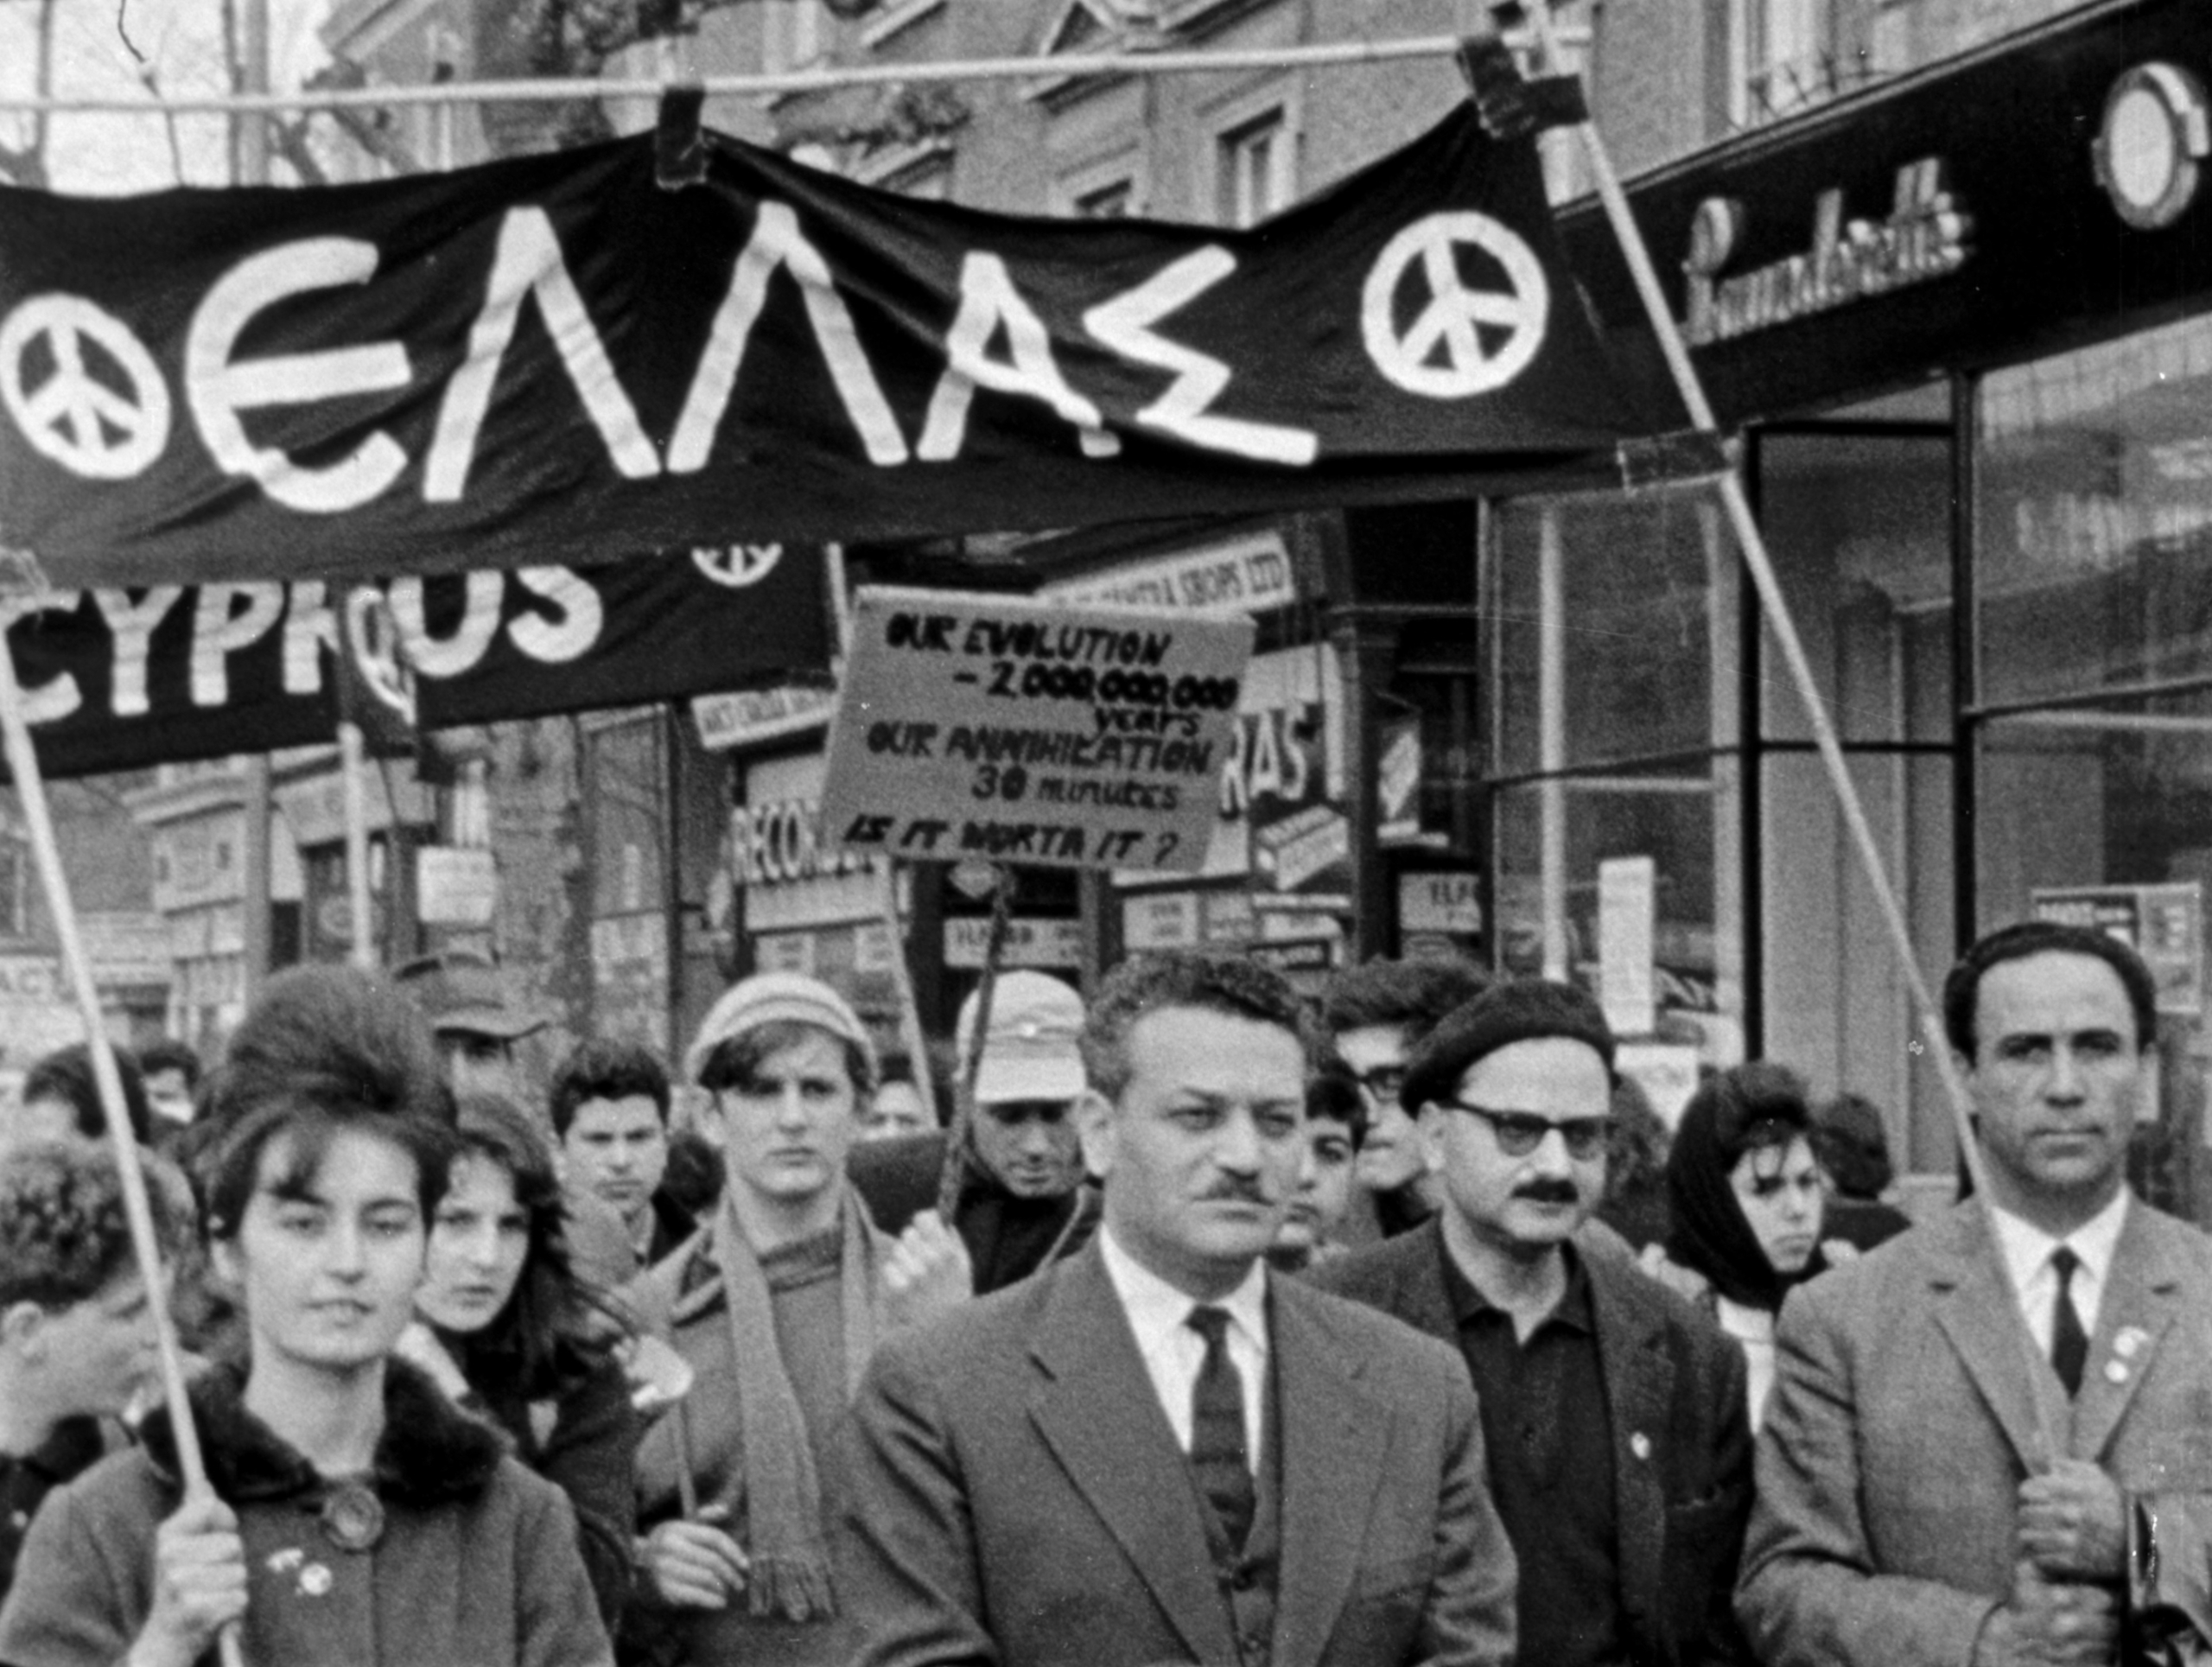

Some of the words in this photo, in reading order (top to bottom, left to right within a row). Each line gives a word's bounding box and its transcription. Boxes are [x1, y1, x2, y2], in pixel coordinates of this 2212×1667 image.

[185, 200, 1319, 513] ΕΛΛΑΣ
[1244, 550, 1285, 595] LTD
[886, 613, 957, 652] OUR
[963, 617, 1172, 666] EVOLUTION
[867, 719, 938, 756] OUR
[1091, 706, 1201, 743] years
[971, 764, 1028, 801] 30
[1039, 777, 1179, 811] minutes
[843, 813, 895, 843] IS
[900, 819, 950, 849] IT
[1095, 830, 1145, 860] IT
[1153, 830, 1180, 864] ?
